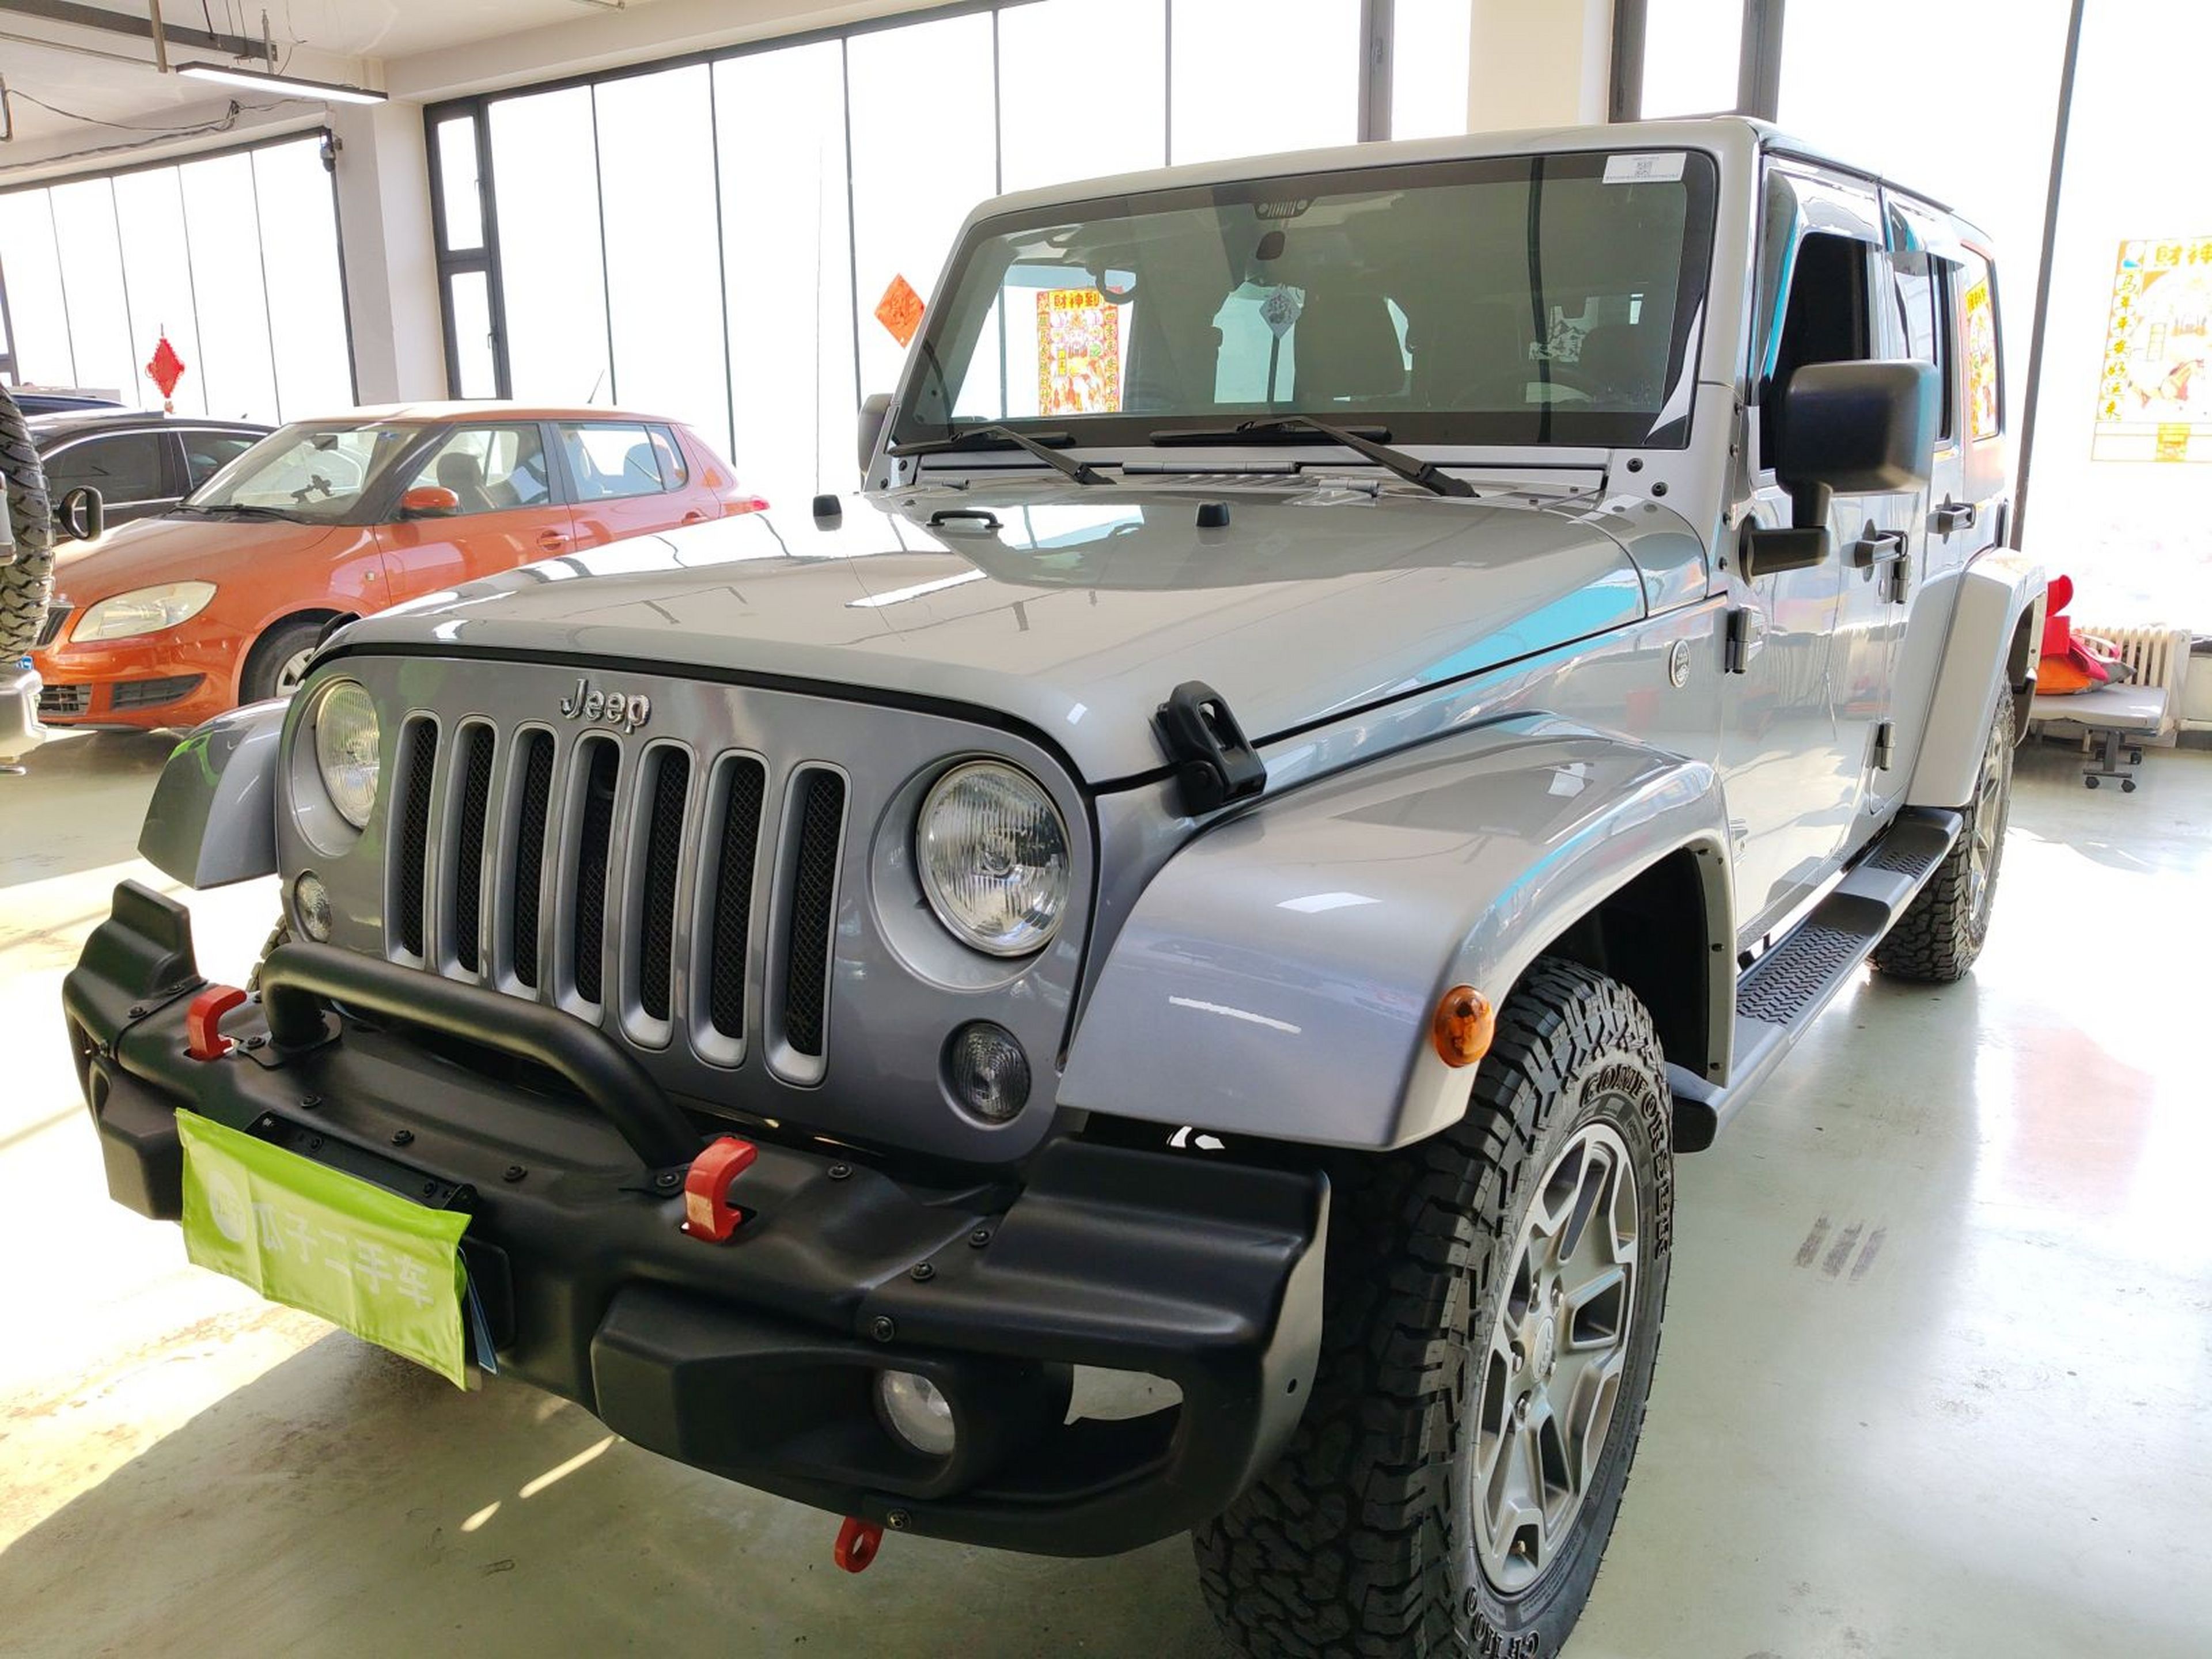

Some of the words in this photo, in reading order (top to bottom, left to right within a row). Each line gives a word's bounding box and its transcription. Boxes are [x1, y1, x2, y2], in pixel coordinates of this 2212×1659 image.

[560, 678, 652, 735] Jeep
[251, 1201, 435, 1309] 瓜子二手车
